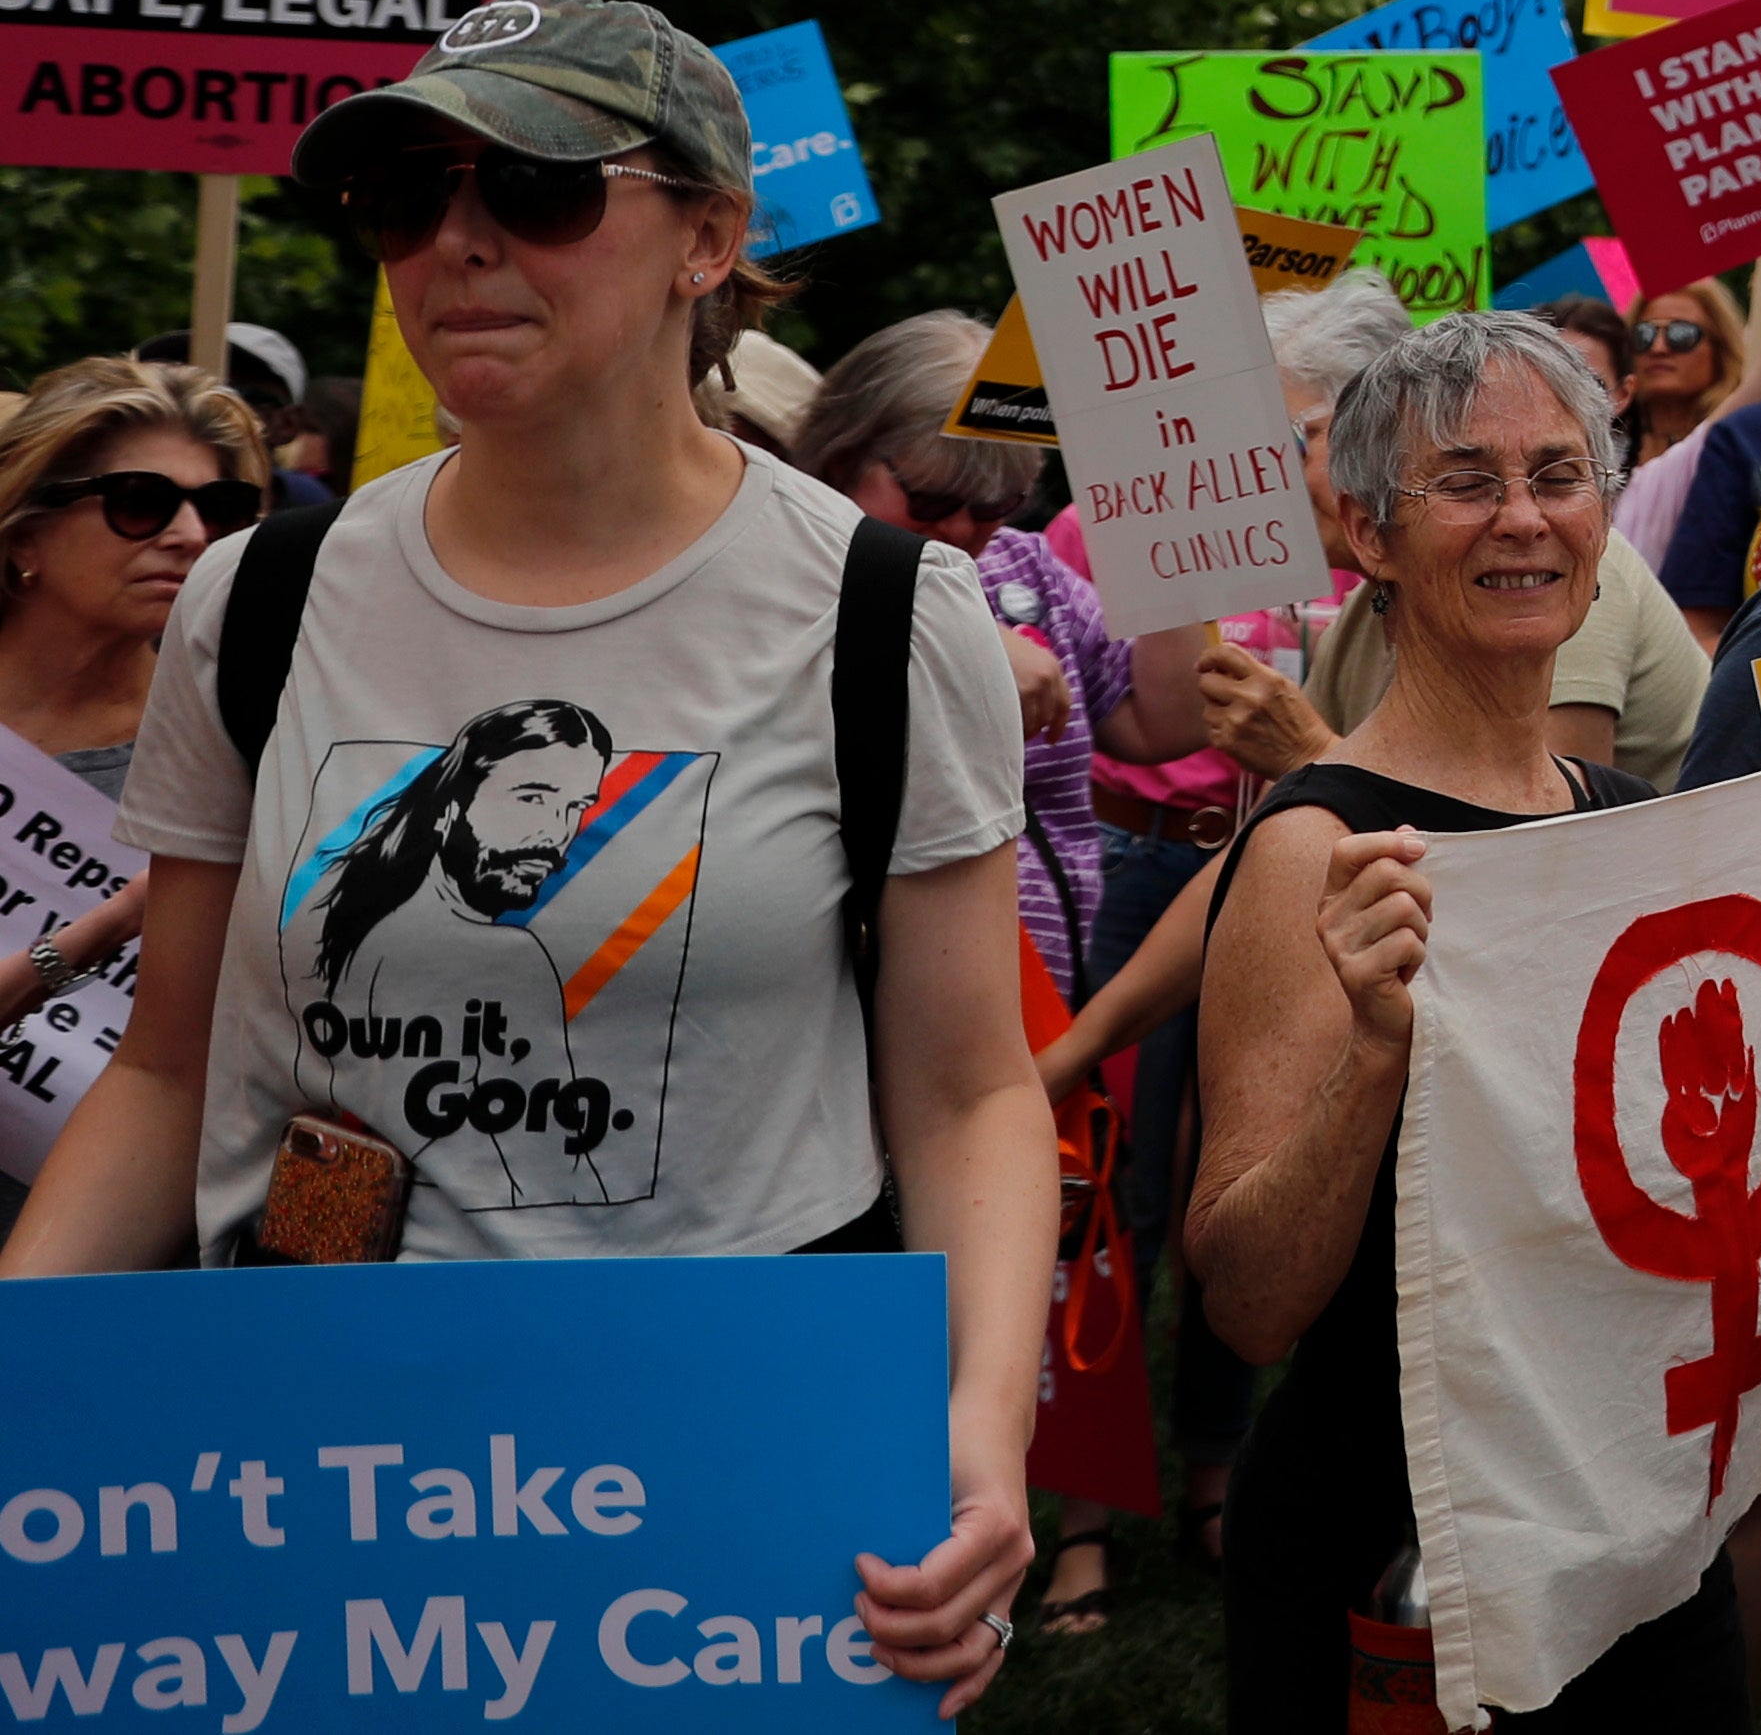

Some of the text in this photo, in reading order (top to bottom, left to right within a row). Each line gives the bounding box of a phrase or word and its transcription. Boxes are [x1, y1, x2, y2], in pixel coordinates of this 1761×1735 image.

[20, 61, 391, 127] ABORTIO
[1247, 56, 1467, 120] STAND
[1633, 68, 1656, 100] I
[1253, 125, 1403, 195] WITH
[1022, 166, 1206, 263] WOMEN
[1076, 250, 1199, 320] WILL
[1241, 233, 1337, 280] Parson
[1095, 313, 1197, 393] DIE
[970, 396, 1020, 419] When
[1156, 409, 1195, 449] in
[1087, 441, 1293, 524] BACK ALLEY
[1150, 518, 1290, 581] CLINICS
[302, 998, 533, 1066] Own it,
[403, 1061, 636, 1156] Gorg.
[316, 1432, 648, 1545] Take
[343, 1594, 557, 1721] My
